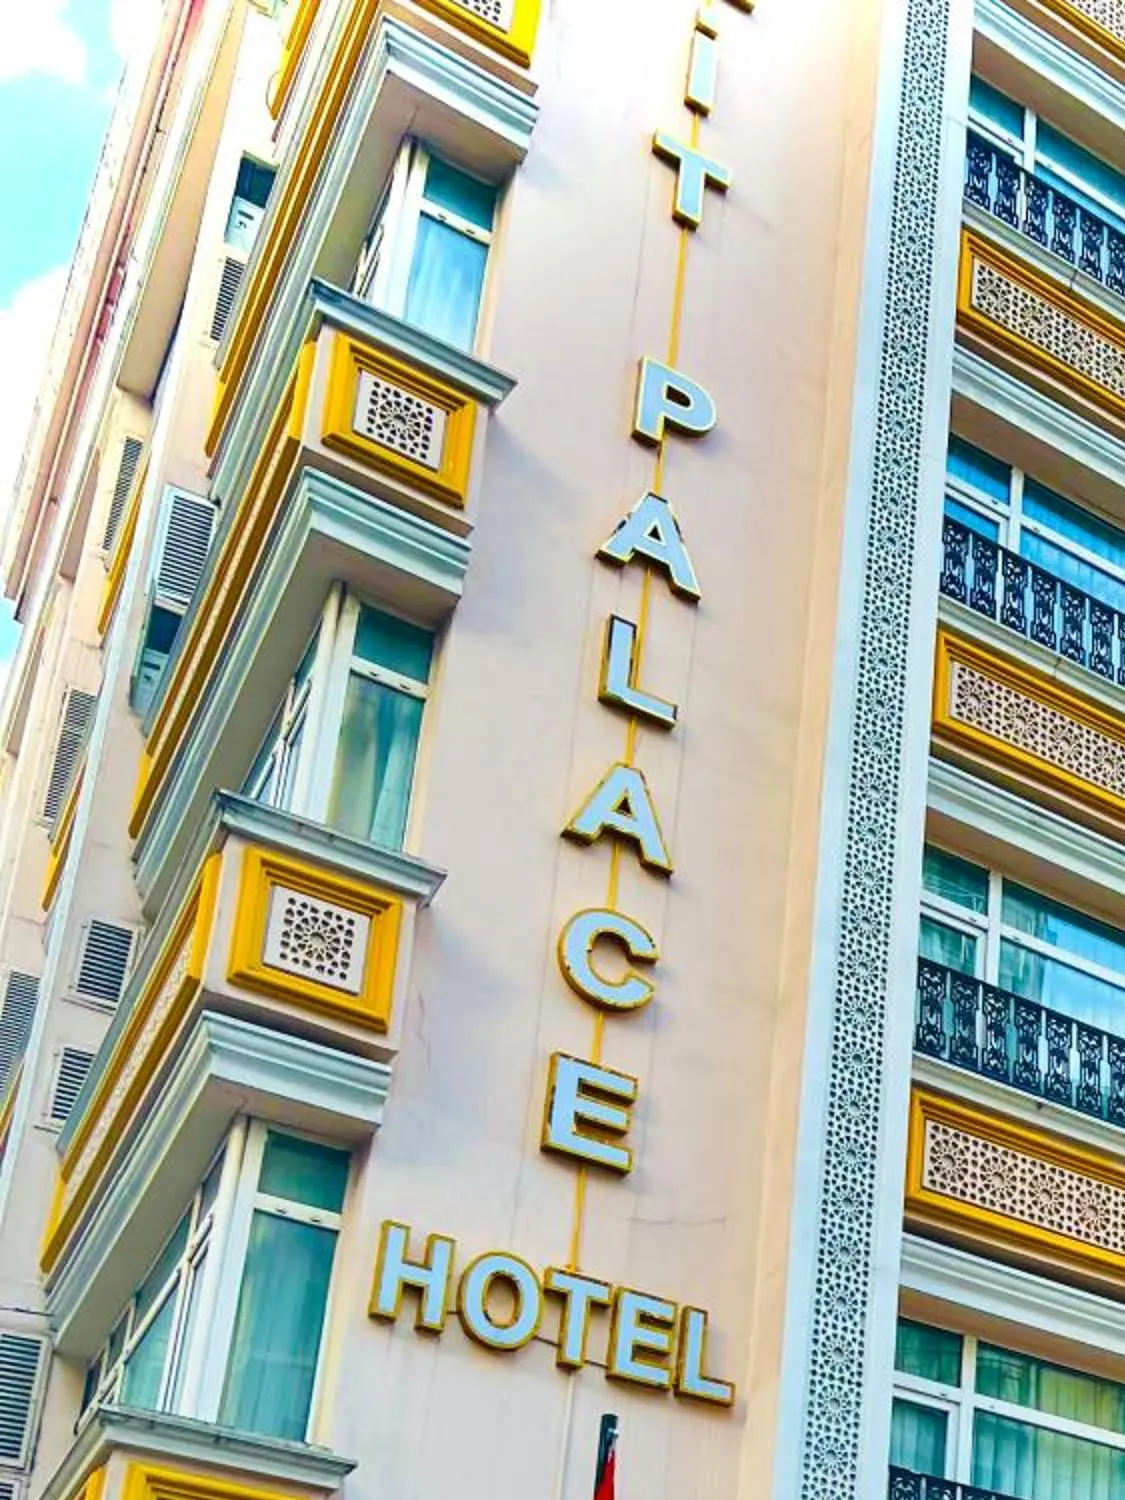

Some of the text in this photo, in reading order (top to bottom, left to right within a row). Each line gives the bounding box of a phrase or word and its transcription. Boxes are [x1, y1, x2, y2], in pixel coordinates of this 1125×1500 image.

[540, 0, 755, 1175] İT PALACE
[367, 1220, 735, 1405] HOTEL
